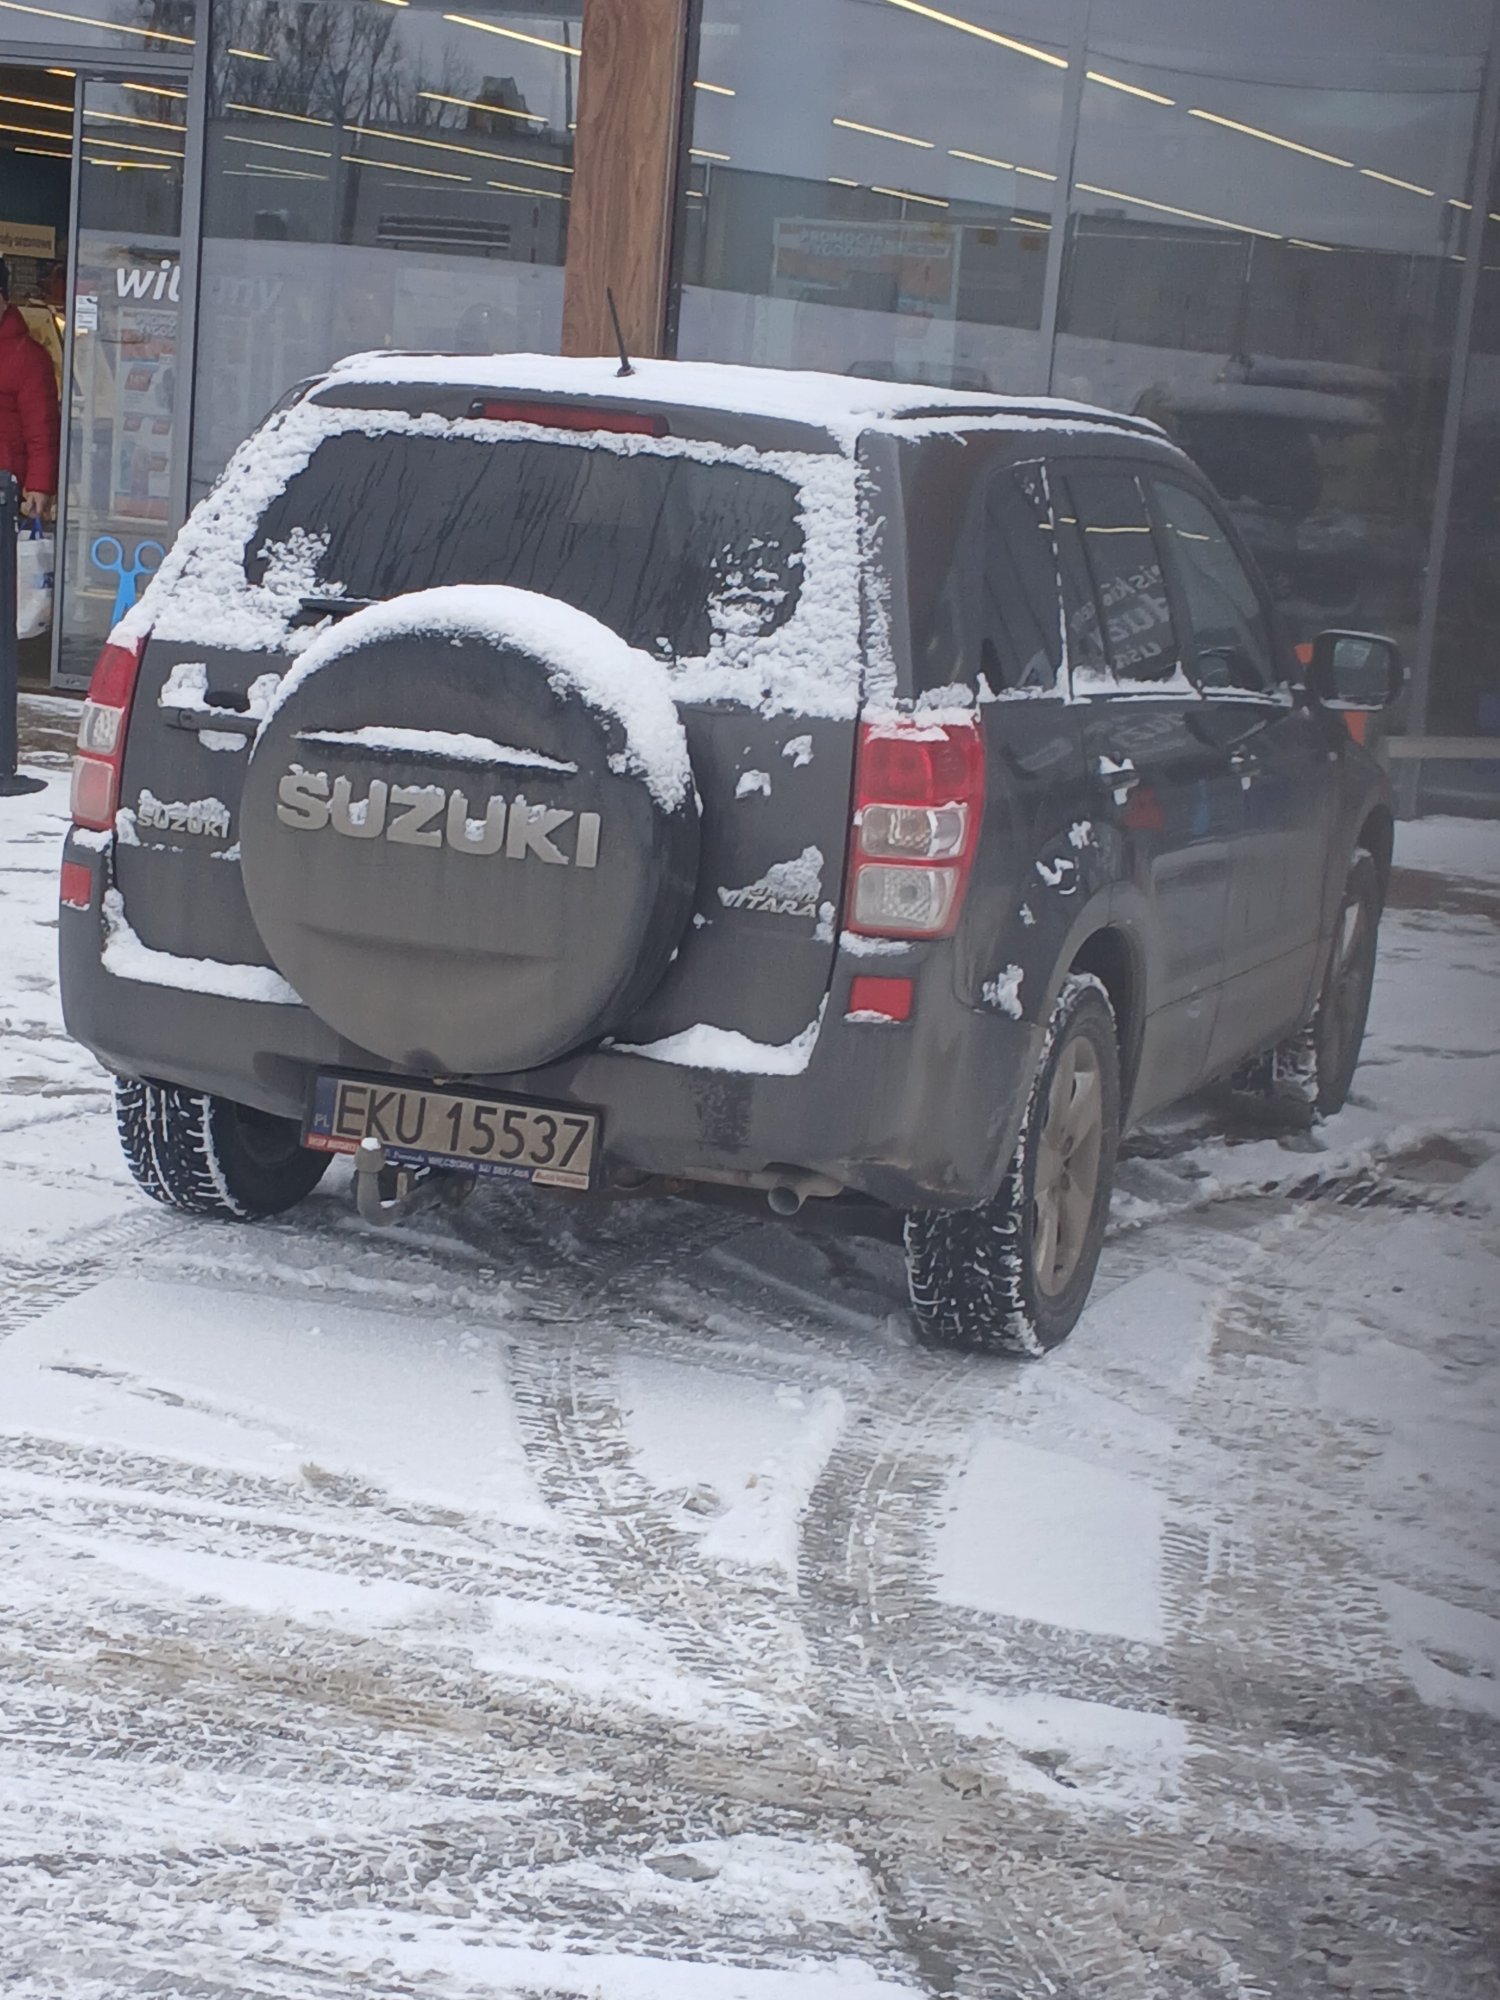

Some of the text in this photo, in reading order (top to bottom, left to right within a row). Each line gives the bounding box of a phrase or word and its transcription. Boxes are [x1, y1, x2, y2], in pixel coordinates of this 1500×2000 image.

[137, 803, 229, 838] SUZUKI
[276, 771, 600, 868] SUZUKI
[718, 887, 816, 918] VITARA
[313, 1112, 331, 1129] PL
[335, 1084, 590, 1168] EKU 15537
